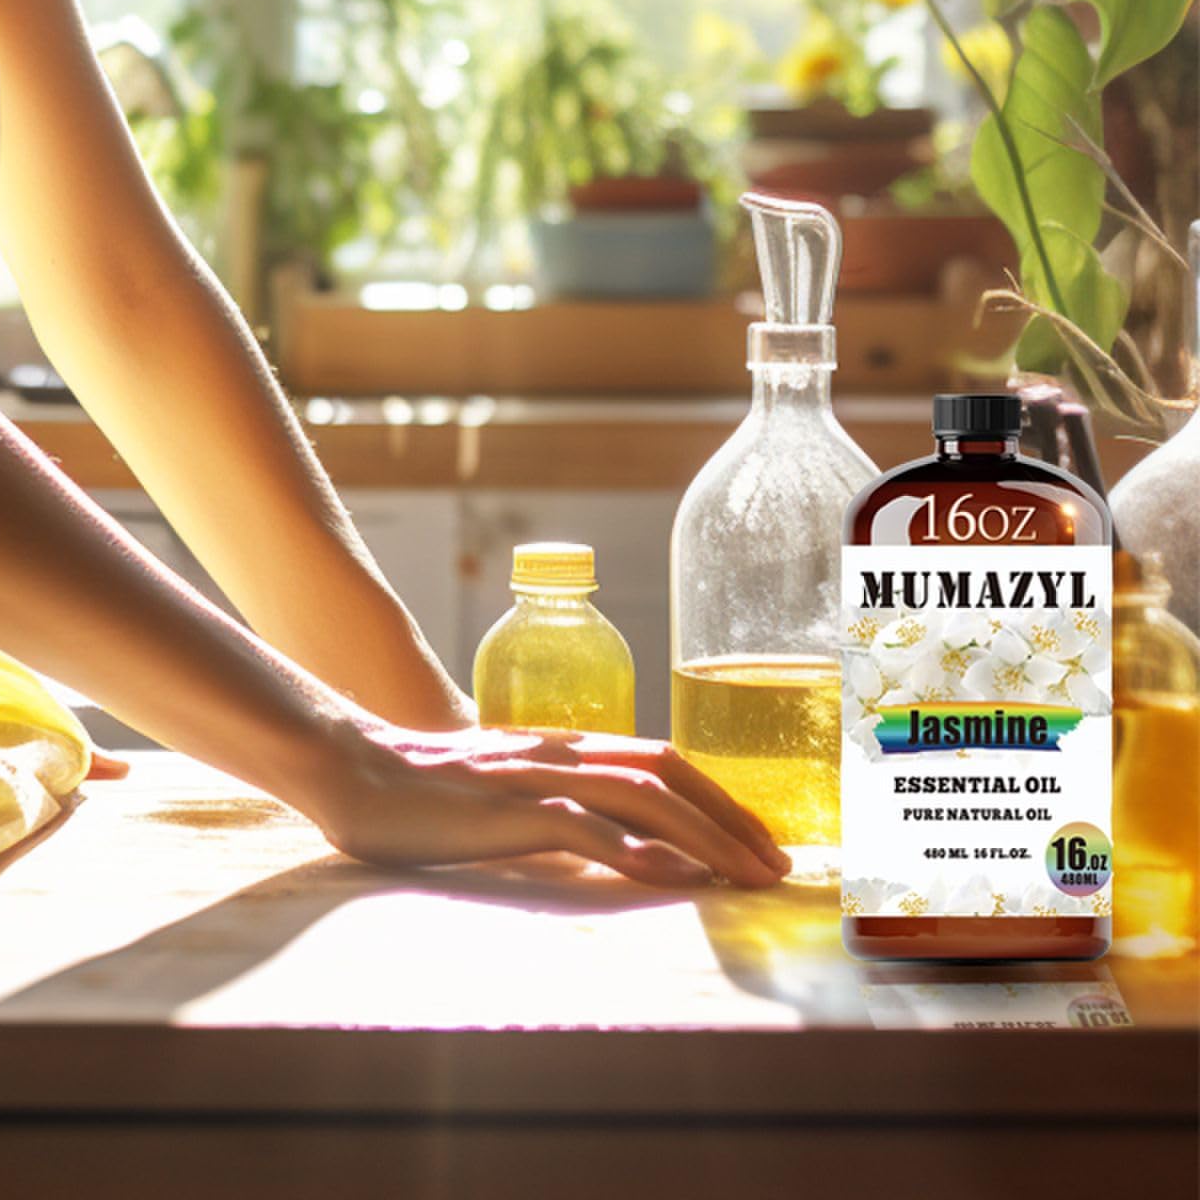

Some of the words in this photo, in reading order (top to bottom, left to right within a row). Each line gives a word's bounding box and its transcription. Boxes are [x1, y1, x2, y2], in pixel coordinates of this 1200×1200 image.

[860, 571, 1095, 609] MUMAZYL
[907, 710, 1048, 746] Jasmine
[894, 776, 1021, 794] ESSENTIAL
[1024, 776, 1062, 794] OIL
[903, 808, 944, 821] PURE
[946, 808, 1024, 821] NATURAL
[1025, 808, 1052, 821] OIL
[923, 847, 946, 859] 480
[947, 847, 969, 859] ML
[973, 847, 988, 859] 16
